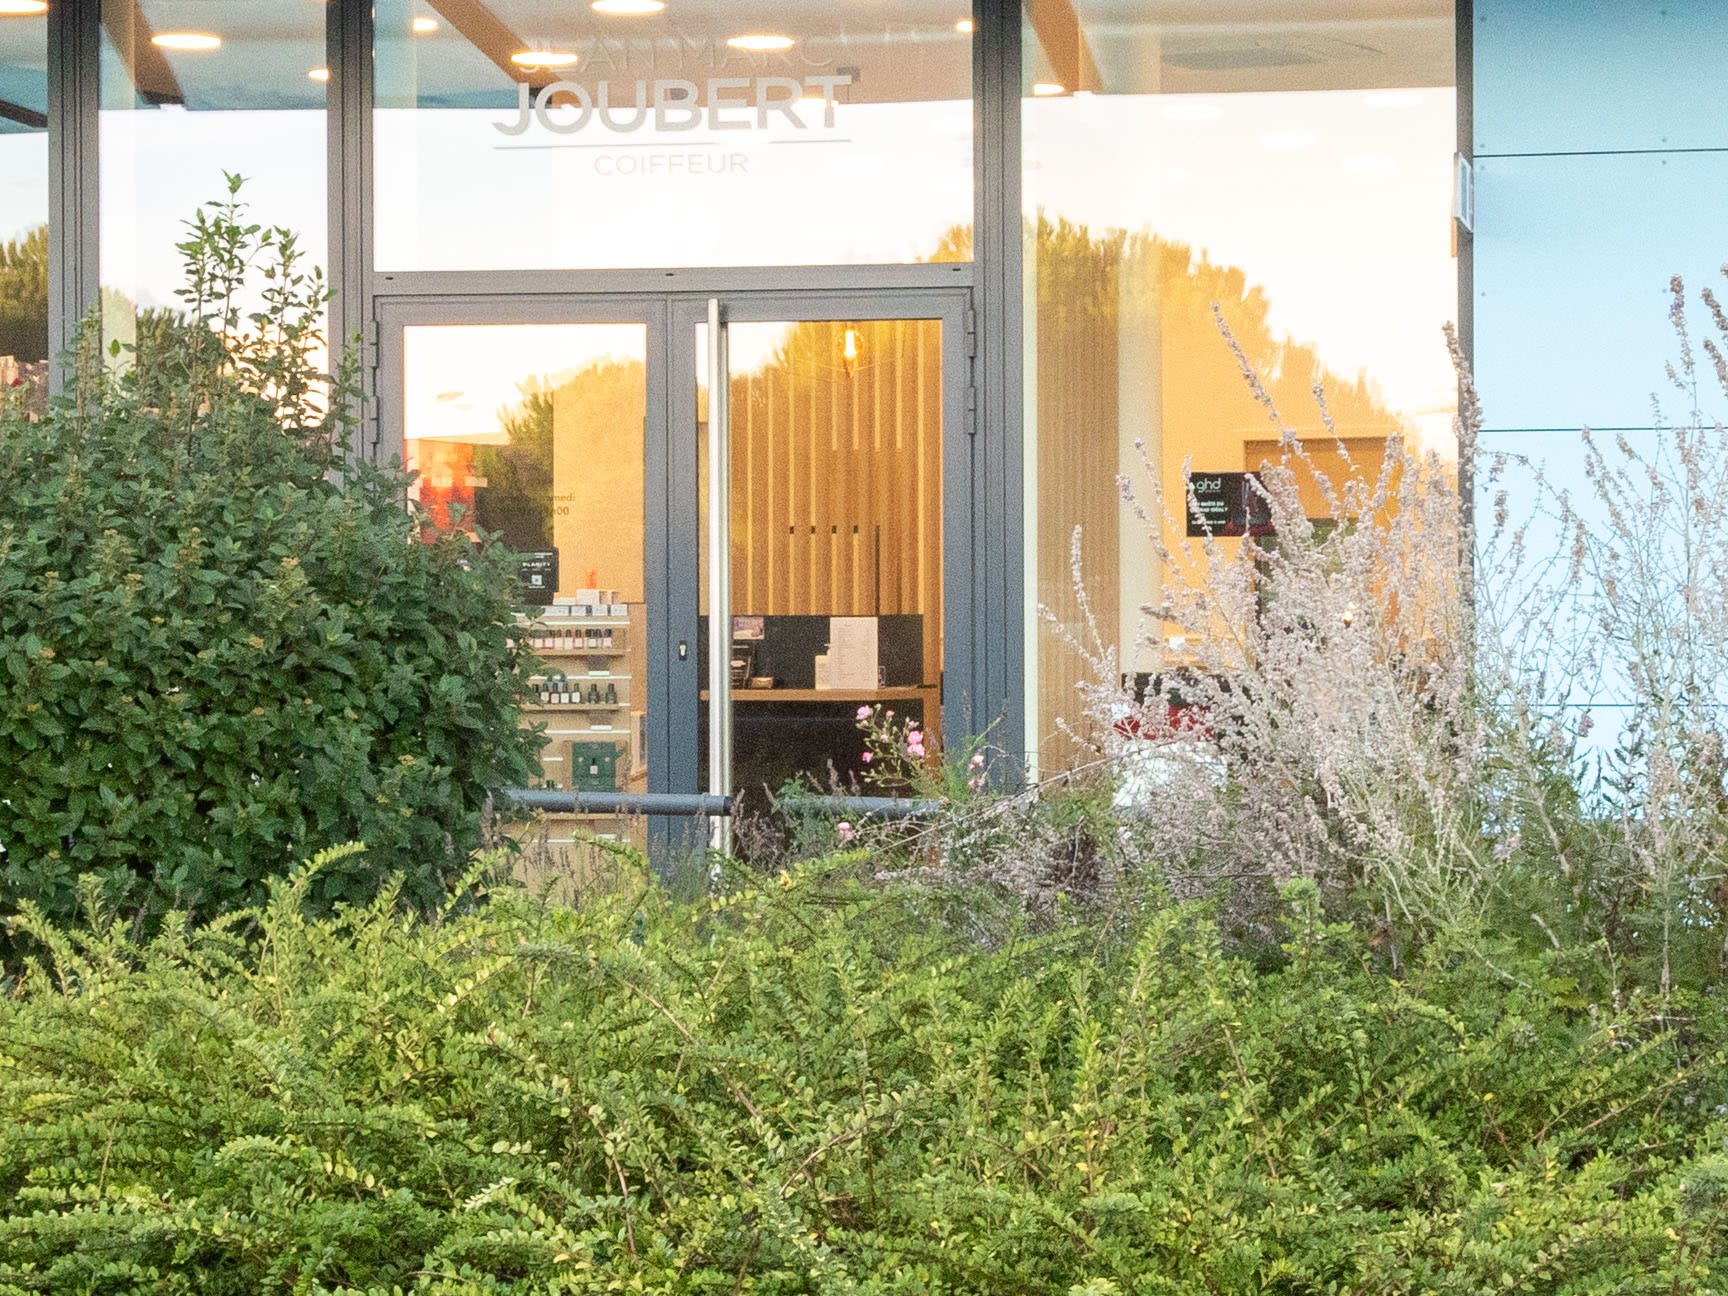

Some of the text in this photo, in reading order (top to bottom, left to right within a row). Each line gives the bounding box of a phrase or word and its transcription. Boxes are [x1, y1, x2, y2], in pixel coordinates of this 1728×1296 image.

[491, 74, 853, 136] JOUBERT
[593, 152, 750, 177] COIFFEUR
[1196, 477, 1221, 493] ghd
